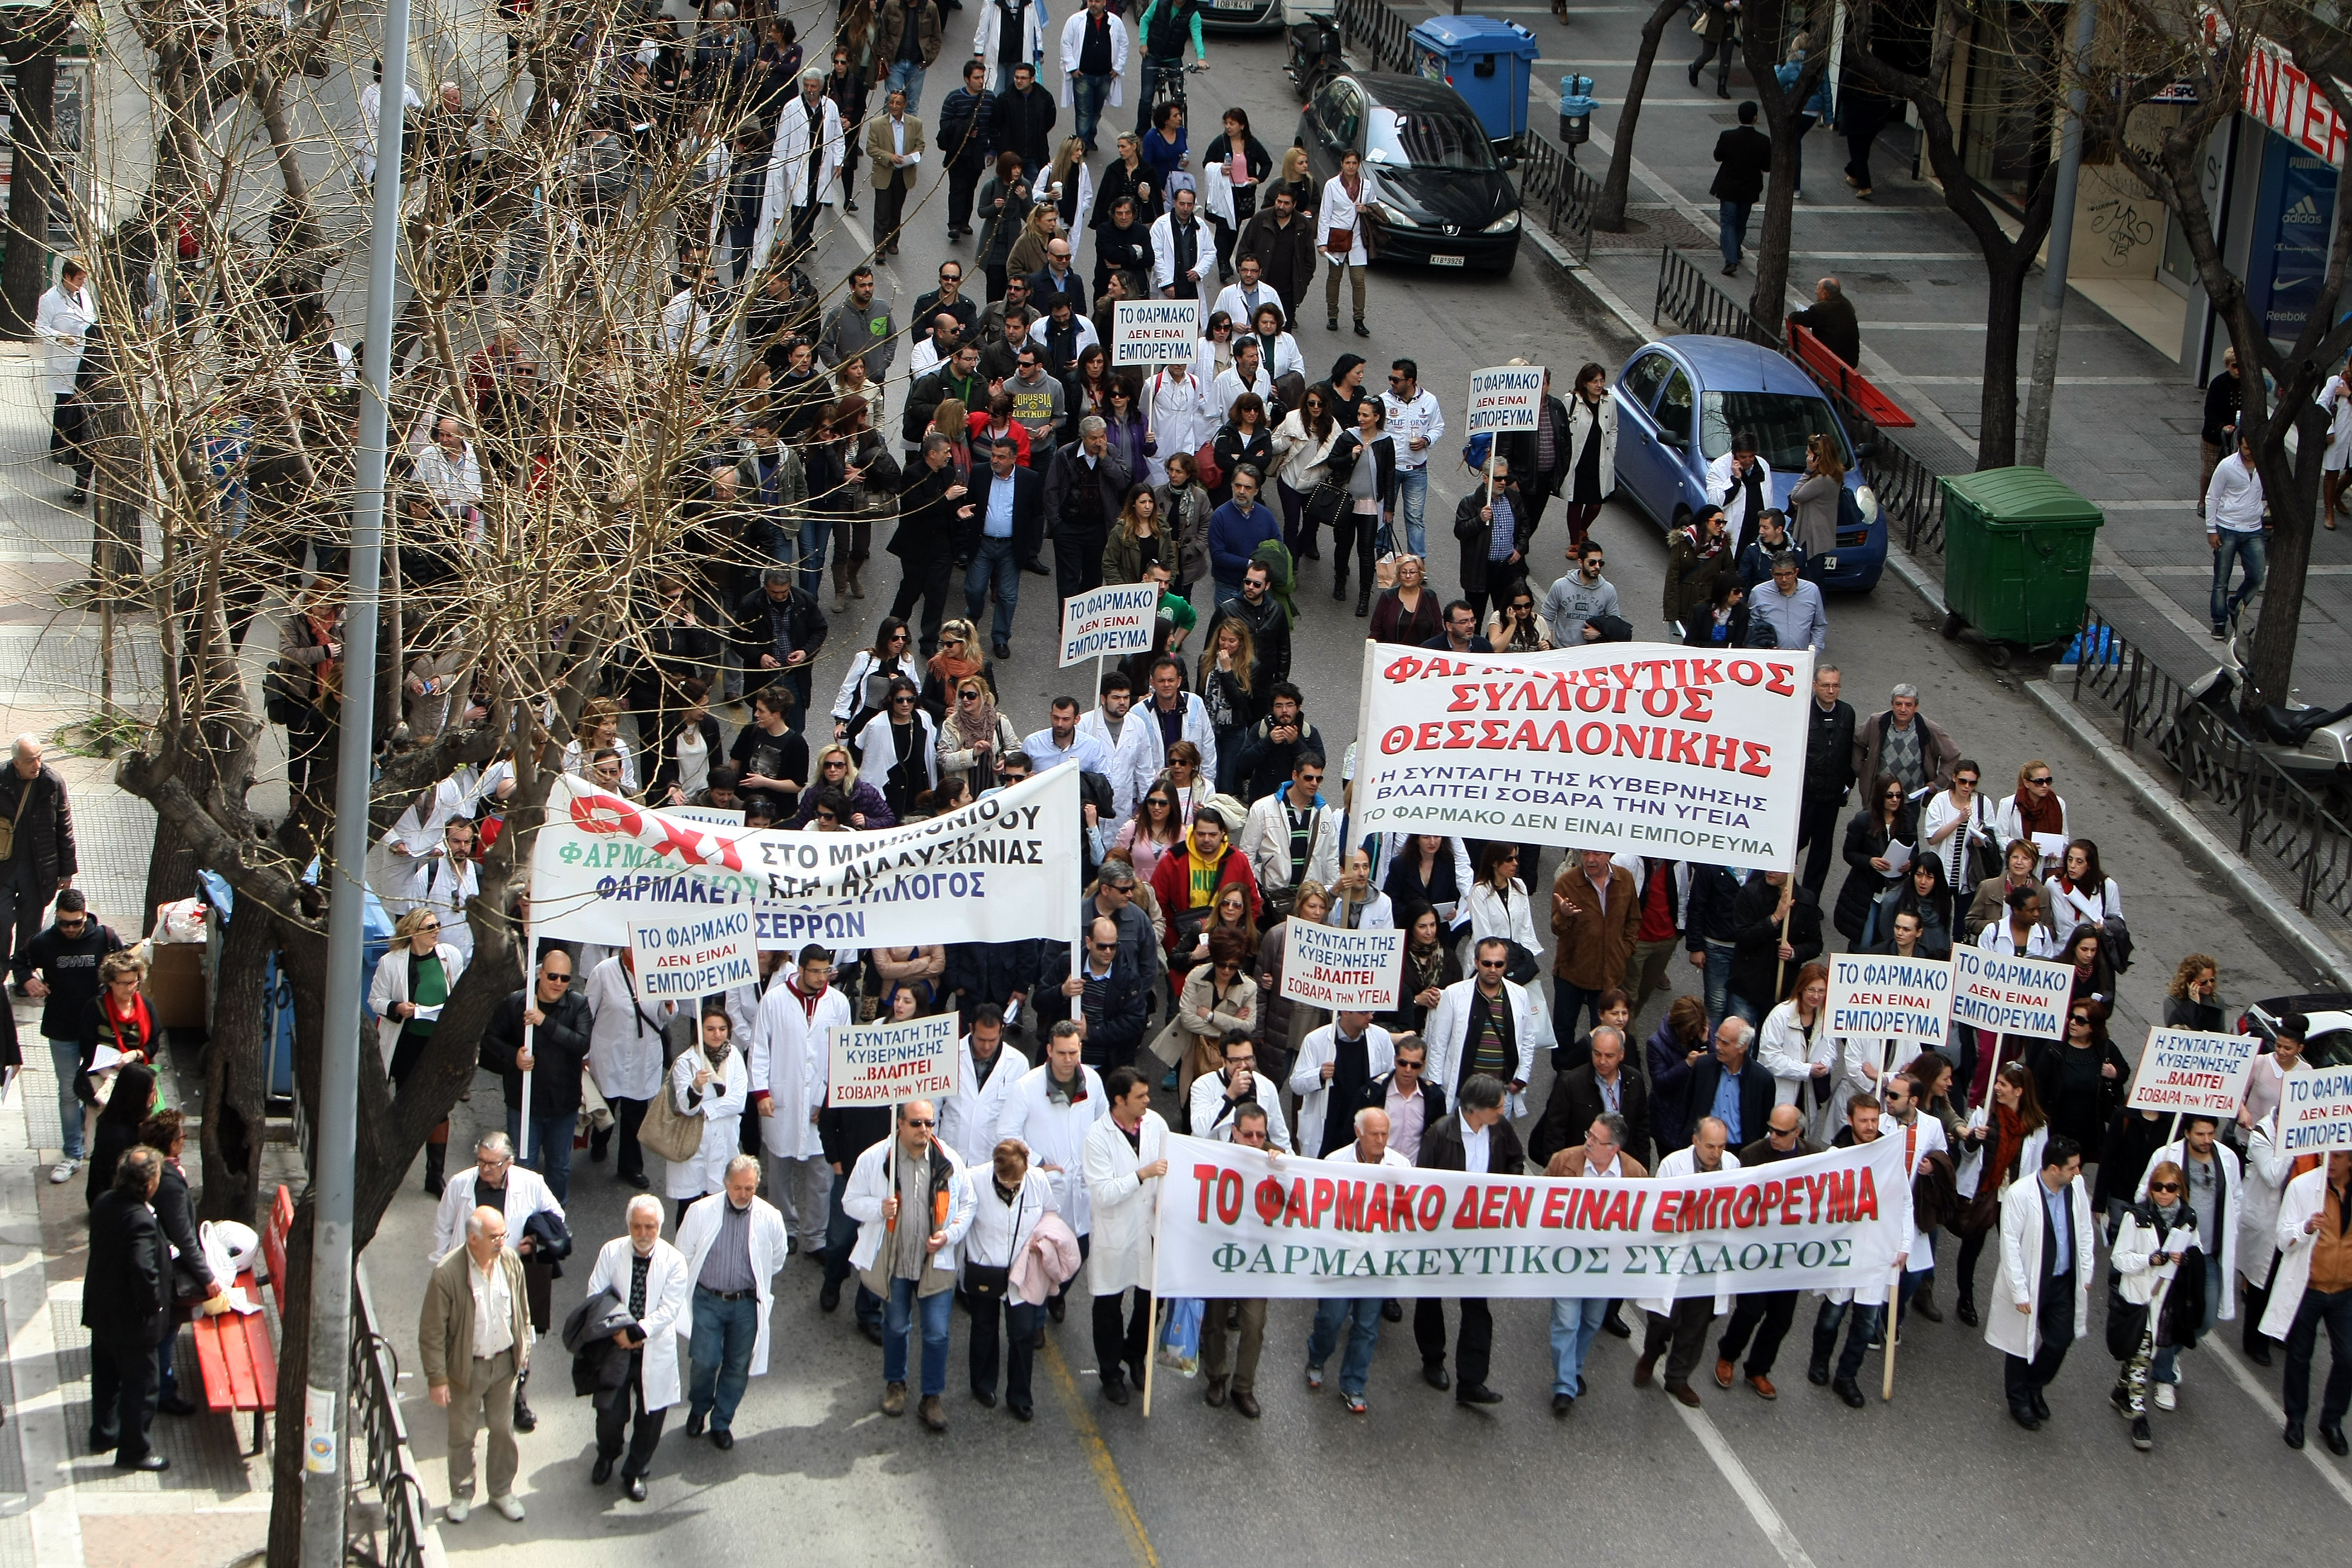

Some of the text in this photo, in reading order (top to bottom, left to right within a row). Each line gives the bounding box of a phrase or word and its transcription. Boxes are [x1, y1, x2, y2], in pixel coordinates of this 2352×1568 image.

[2282, 213, 2322, 224] adidas
[1119, 307, 1195, 324] ΤΟ ΦΑΡΜΑΚΟ
[2266, 310, 2307, 322] Reebok
[1128, 329, 1184, 339] ΔΕΝ ΕΙΝΑΙ
[1119, 342, 1193, 360] ΕΜΠΟΡΕΥΜΑ
[1472, 373, 1540, 394] ΤΟ ΦΑΡΜΑΚΟ
[1476, 395, 1527, 408] ΔΕΝ ΕΙΝΑΙ
[1469, 409, 1534, 431] ΕΜΠΟΡΕΥΜΑ
[1070, 590, 1153, 622] ΤΟ ΦΑΡΜΑΚΟ
[1077, 615, 1139, 635] ΔΕΝ ΕΙΝΑΙ
[1067, 629, 1148, 660] ΕΜΠΟΡΕΥΜΑ
[1383, 655, 1795, 697] ΦΑΡΕΥΤΙΚΟΣ
[1380, 718, 1772, 779] ΘΕΣΣΑΛΟΝΙΚΗΣ
[1380, 766, 1768, 812] Η ΣΥΝΤΑΓΗ ΤΗΣ ΚΥΒΕΡΝΗΣΗΣ
[982, 805, 1042, 833] ΟΥ
[1376, 784, 1751, 829] ΒΛΑΠΤΕΙ ΣΟΒΑΡΑ ΤΗΝ ΥΓΕΙΑ
[570, 795, 743, 873] ΟΧΙ
[760, 841, 818, 869] ΣΤΟ
[1363, 806, 1775, 857] ΤΟ ΦΑΡΜΑΚΟ ΔΕΝ ΕΙΝΑΙ ΕΜΠΟΡΕΥΜΑ
[558, 841, 760, 897] ΦΑΡΜΑΙΟΥ
[838, 871, 985, 905] ΛΛΟΓΟΣ
[638, 912, 748, 949] ΤΟ ΦΑΡΜΑΚΟ
[756, 910, 867, 939] ΣΕΡΡΩΝ
[1294, 924, 1396, 951] Η ΣΥΝΤΑΓΗ ΤΗΣ
[656, 943, 737, 968] ΔΕΝ ΕΙΝΑΙ
[1298, 944, 1388, 968] ΚΥΒΕΡΝΗΣΗΣ
[645, 958, 753, 994] ΕΜΠΟΡΕΥΜΑ
[1837, 962, 1948, 991] ΤΟ ΦΑΡΜΑΚΟ
[1958, 952, 2066, 991] ΤΟ ΦΑΡΜΑΚΟ
[1287, 977, 1333, 1002] ΣΟΒΑΡΑ
[1357, 989, 1391, 1004] ΥΓΕΙΑ
[1848, 992, 1931, 1010] ΔΕΝ ΕΙΝΑΙ
[1967, 983, 2049, 1008] ΔΕΝ ΕΙΝΑΙ
[1834, 1009, 1941, 1037] ΕΜΠΟΡΕΥΜΑ
[1952, 995, 2057, 1033] ΕΜΠΟΡΕΥΜΑ
[840, 1021, 950, 1047] Η ΣΥΝΤΑΓΗ ΤΗΣ
[2154, 1034, 2252, 1058] Η ΣΥΝΤΑΓΗ ΤΗΣ
[846, 1039, 944, 1063] ΚΥΒΕΡΝΗΣΗΣ
[2155, 1052, 2240, 1074] ΚΥΒΕΡΝΗΣΗΣ
[837, 1084, 889, 1100] ΣΟΒΑΡΑ
[915, 1075, 951, 1094] ΥΓΕΙΑ
[2136, 1086, 2181, 1105] ΣΟΒΑΡΑ
[2203, 1093, 2234, 1111] ΥΓΕΙΑ
[2288, 1080, 2308, 1102] ΤΟ
[2299, 1106, 2328, 1121] ΔΕΝ
[1194, 1164, 1880, 1233] ΤΟ ΦΑΡΜΑΚΟ ΔΕΝ ΕΙΝΑΙ ΕΜΠΟΡΕΥΜΑ
[1211, 1239, 1853, 1276] ΦΑΡΜΑΚΕΥΤΙΚΟΣ ΣΥΛΛΟΓΟΣ
